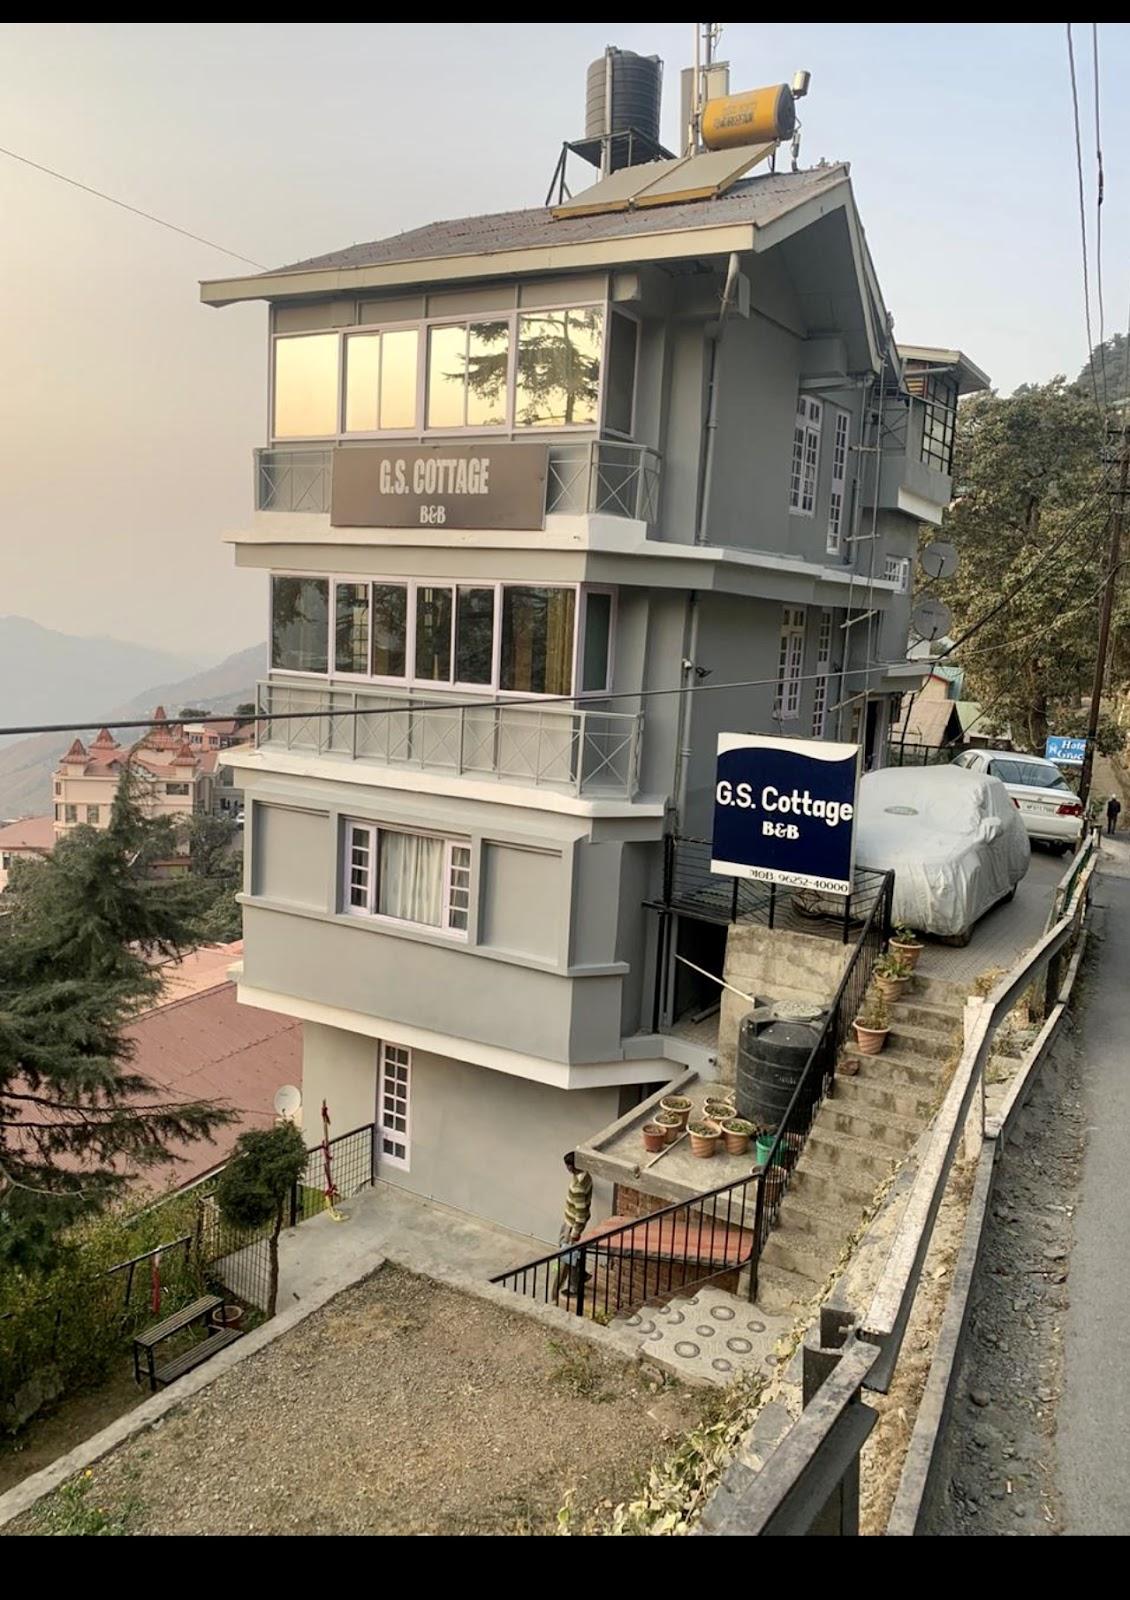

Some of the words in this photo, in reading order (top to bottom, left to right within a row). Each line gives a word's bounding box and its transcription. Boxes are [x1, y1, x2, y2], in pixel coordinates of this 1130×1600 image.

[379, 458, 410, 495] G.S.
[413, 457, 490, 495] COTTAGE
[419, 505, 446, 524] B&B
[1061, 740, 1086, 751] Hote
[716, 780, 757, 809] G.S.
[761, 785, 854, 827] Cottage
[762, 820, 800, 840] B&B
[778, 874, 848, 893] 96252-40000
